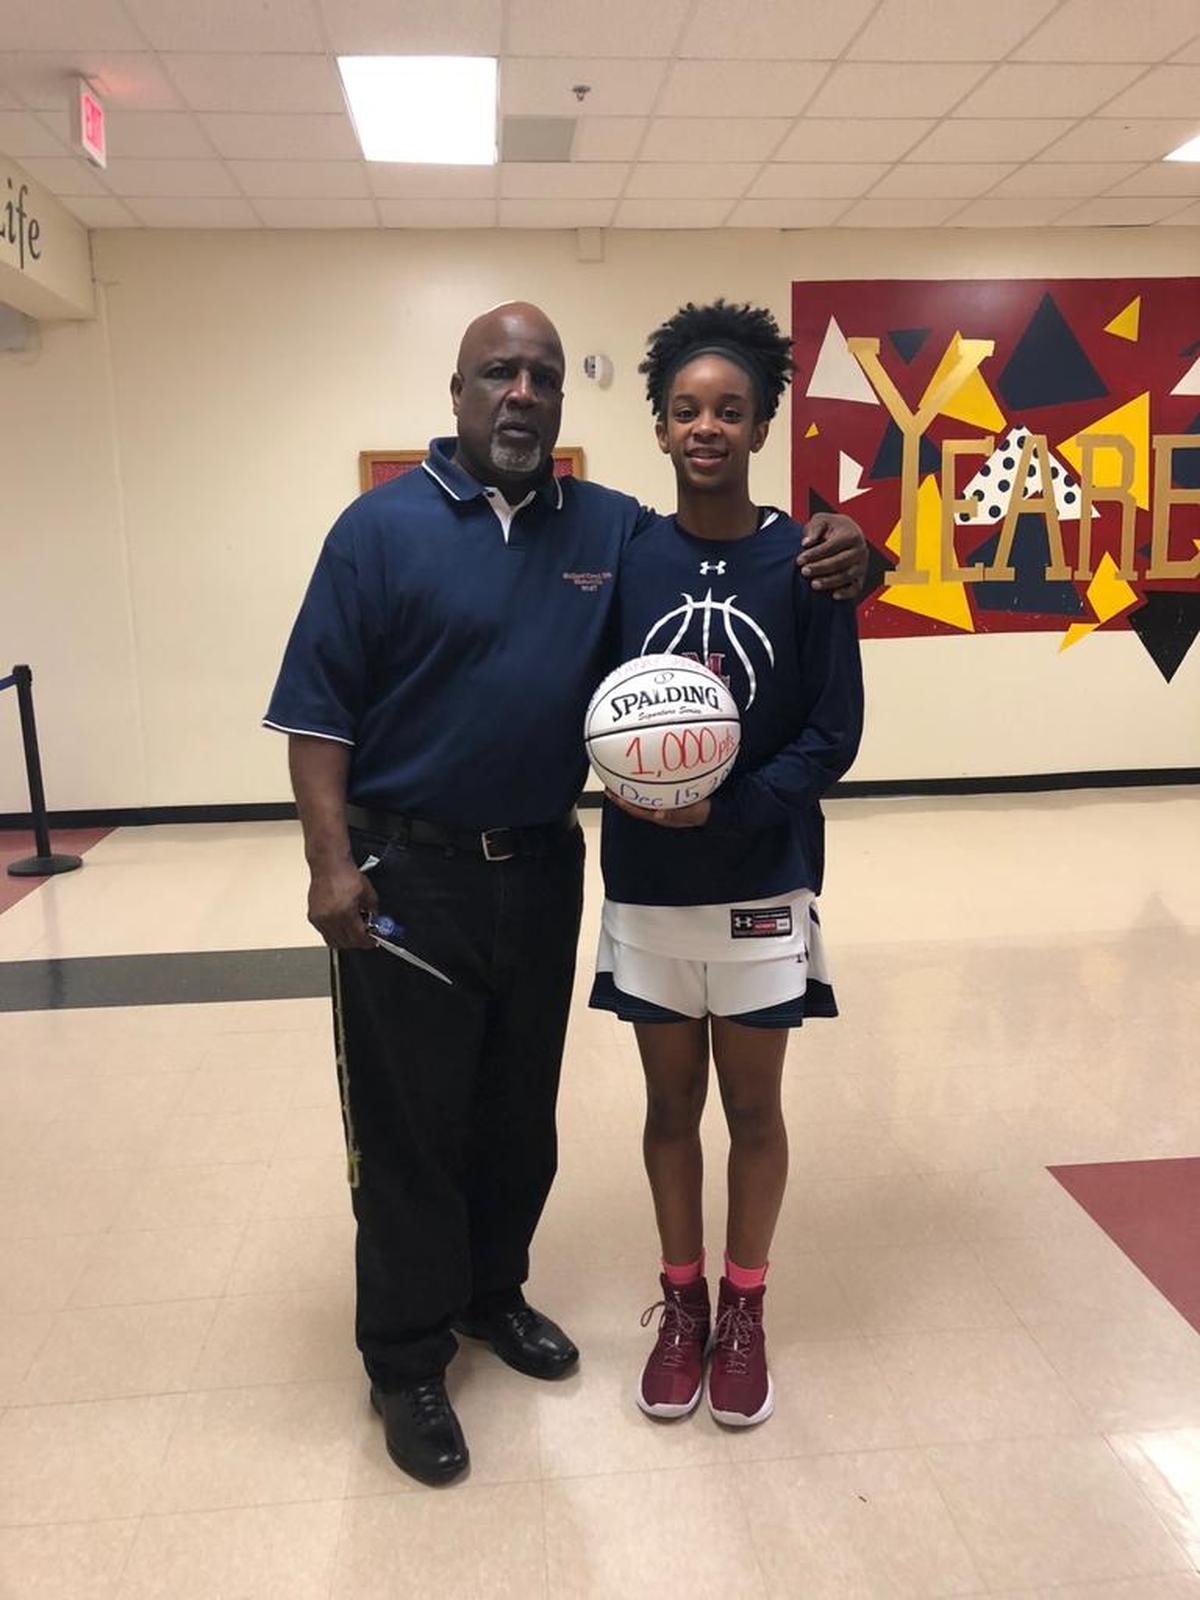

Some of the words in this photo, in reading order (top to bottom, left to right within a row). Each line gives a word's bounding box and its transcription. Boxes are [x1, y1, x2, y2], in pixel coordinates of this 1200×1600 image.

[0, 176, 41, 269] ife
[611, 686, 719, 722] SPALDING
[626, 727, 718, 778] 1,000
[620, 783, 664, 808] Dec
